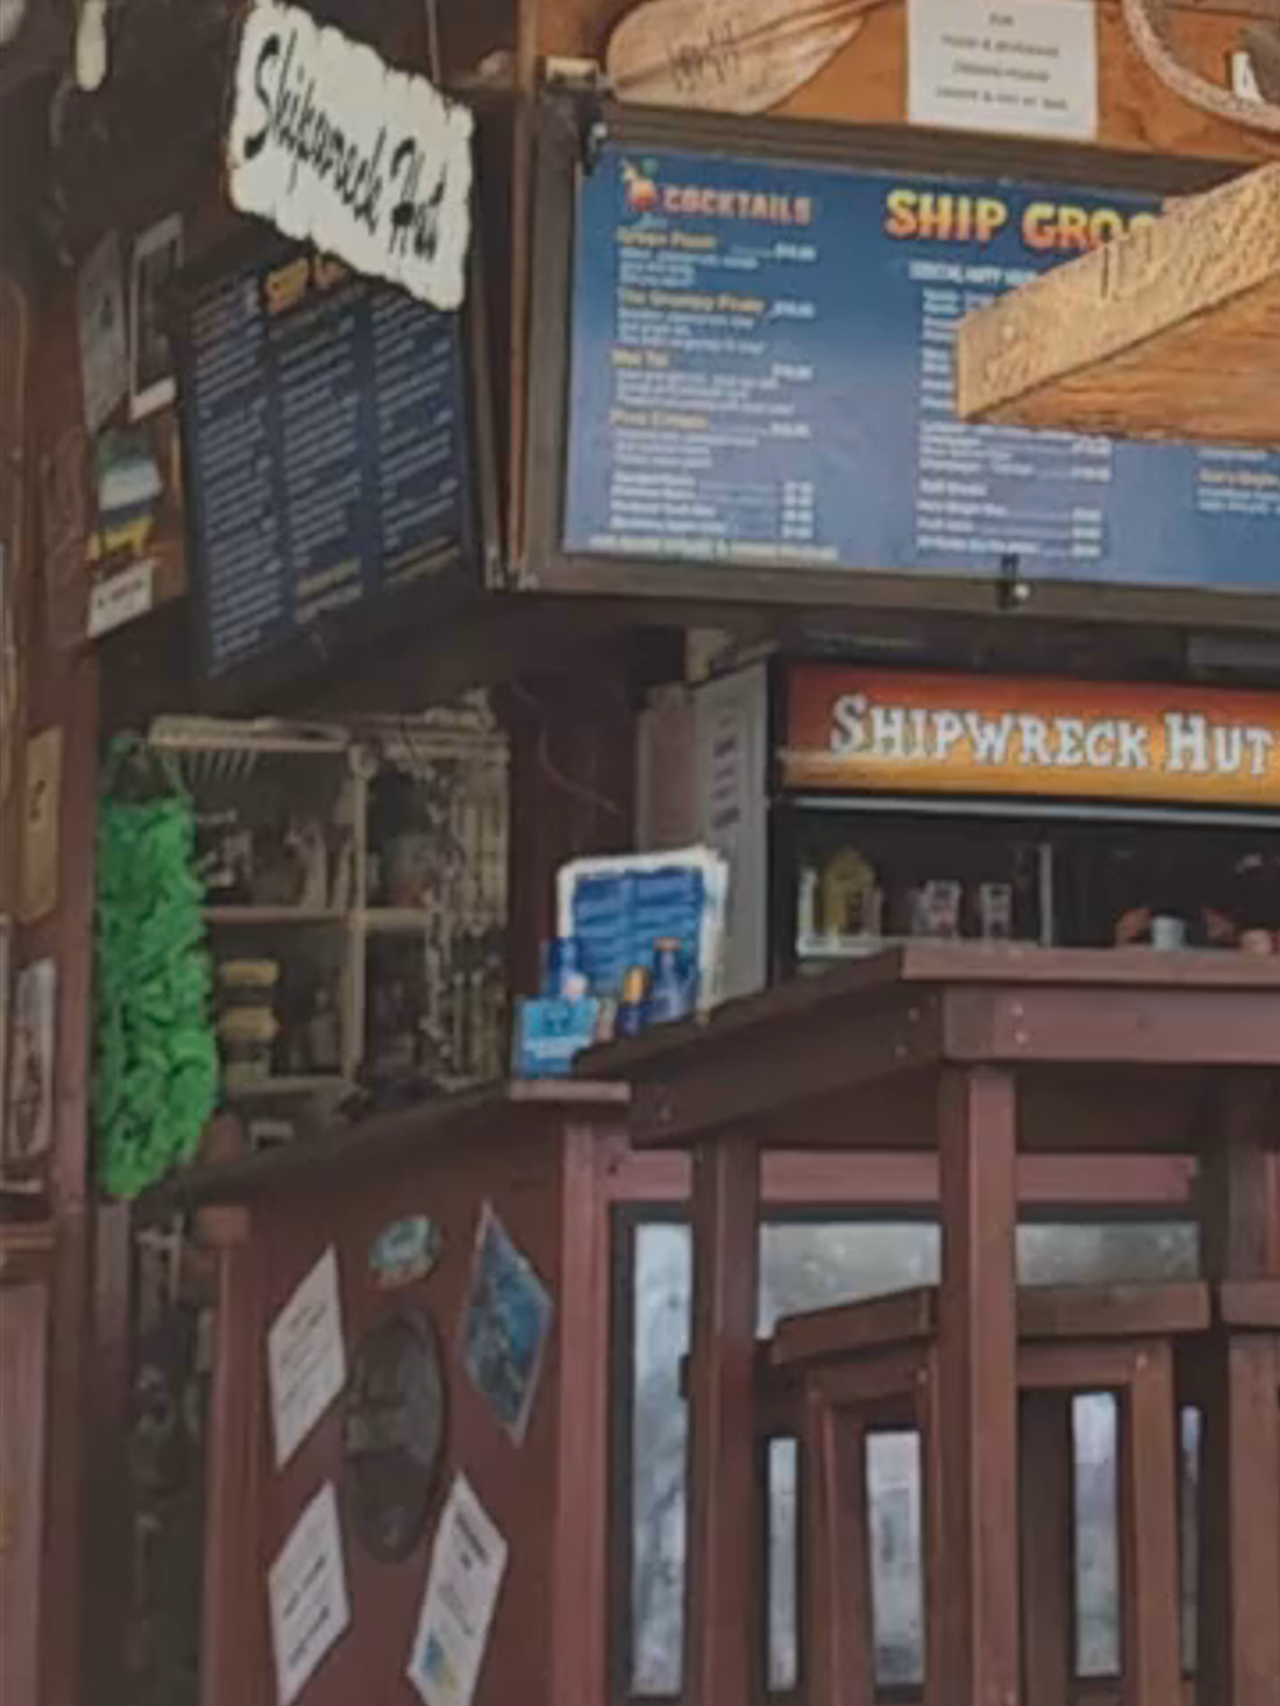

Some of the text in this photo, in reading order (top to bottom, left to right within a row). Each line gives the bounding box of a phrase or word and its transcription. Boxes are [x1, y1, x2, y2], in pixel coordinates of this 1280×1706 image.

[661, 183, 811, 227] COCKTAILS
[885, 188, 1156, 249] SHIP GRO
[829, 692, 1274, 775] SHIPWRECK HUT
